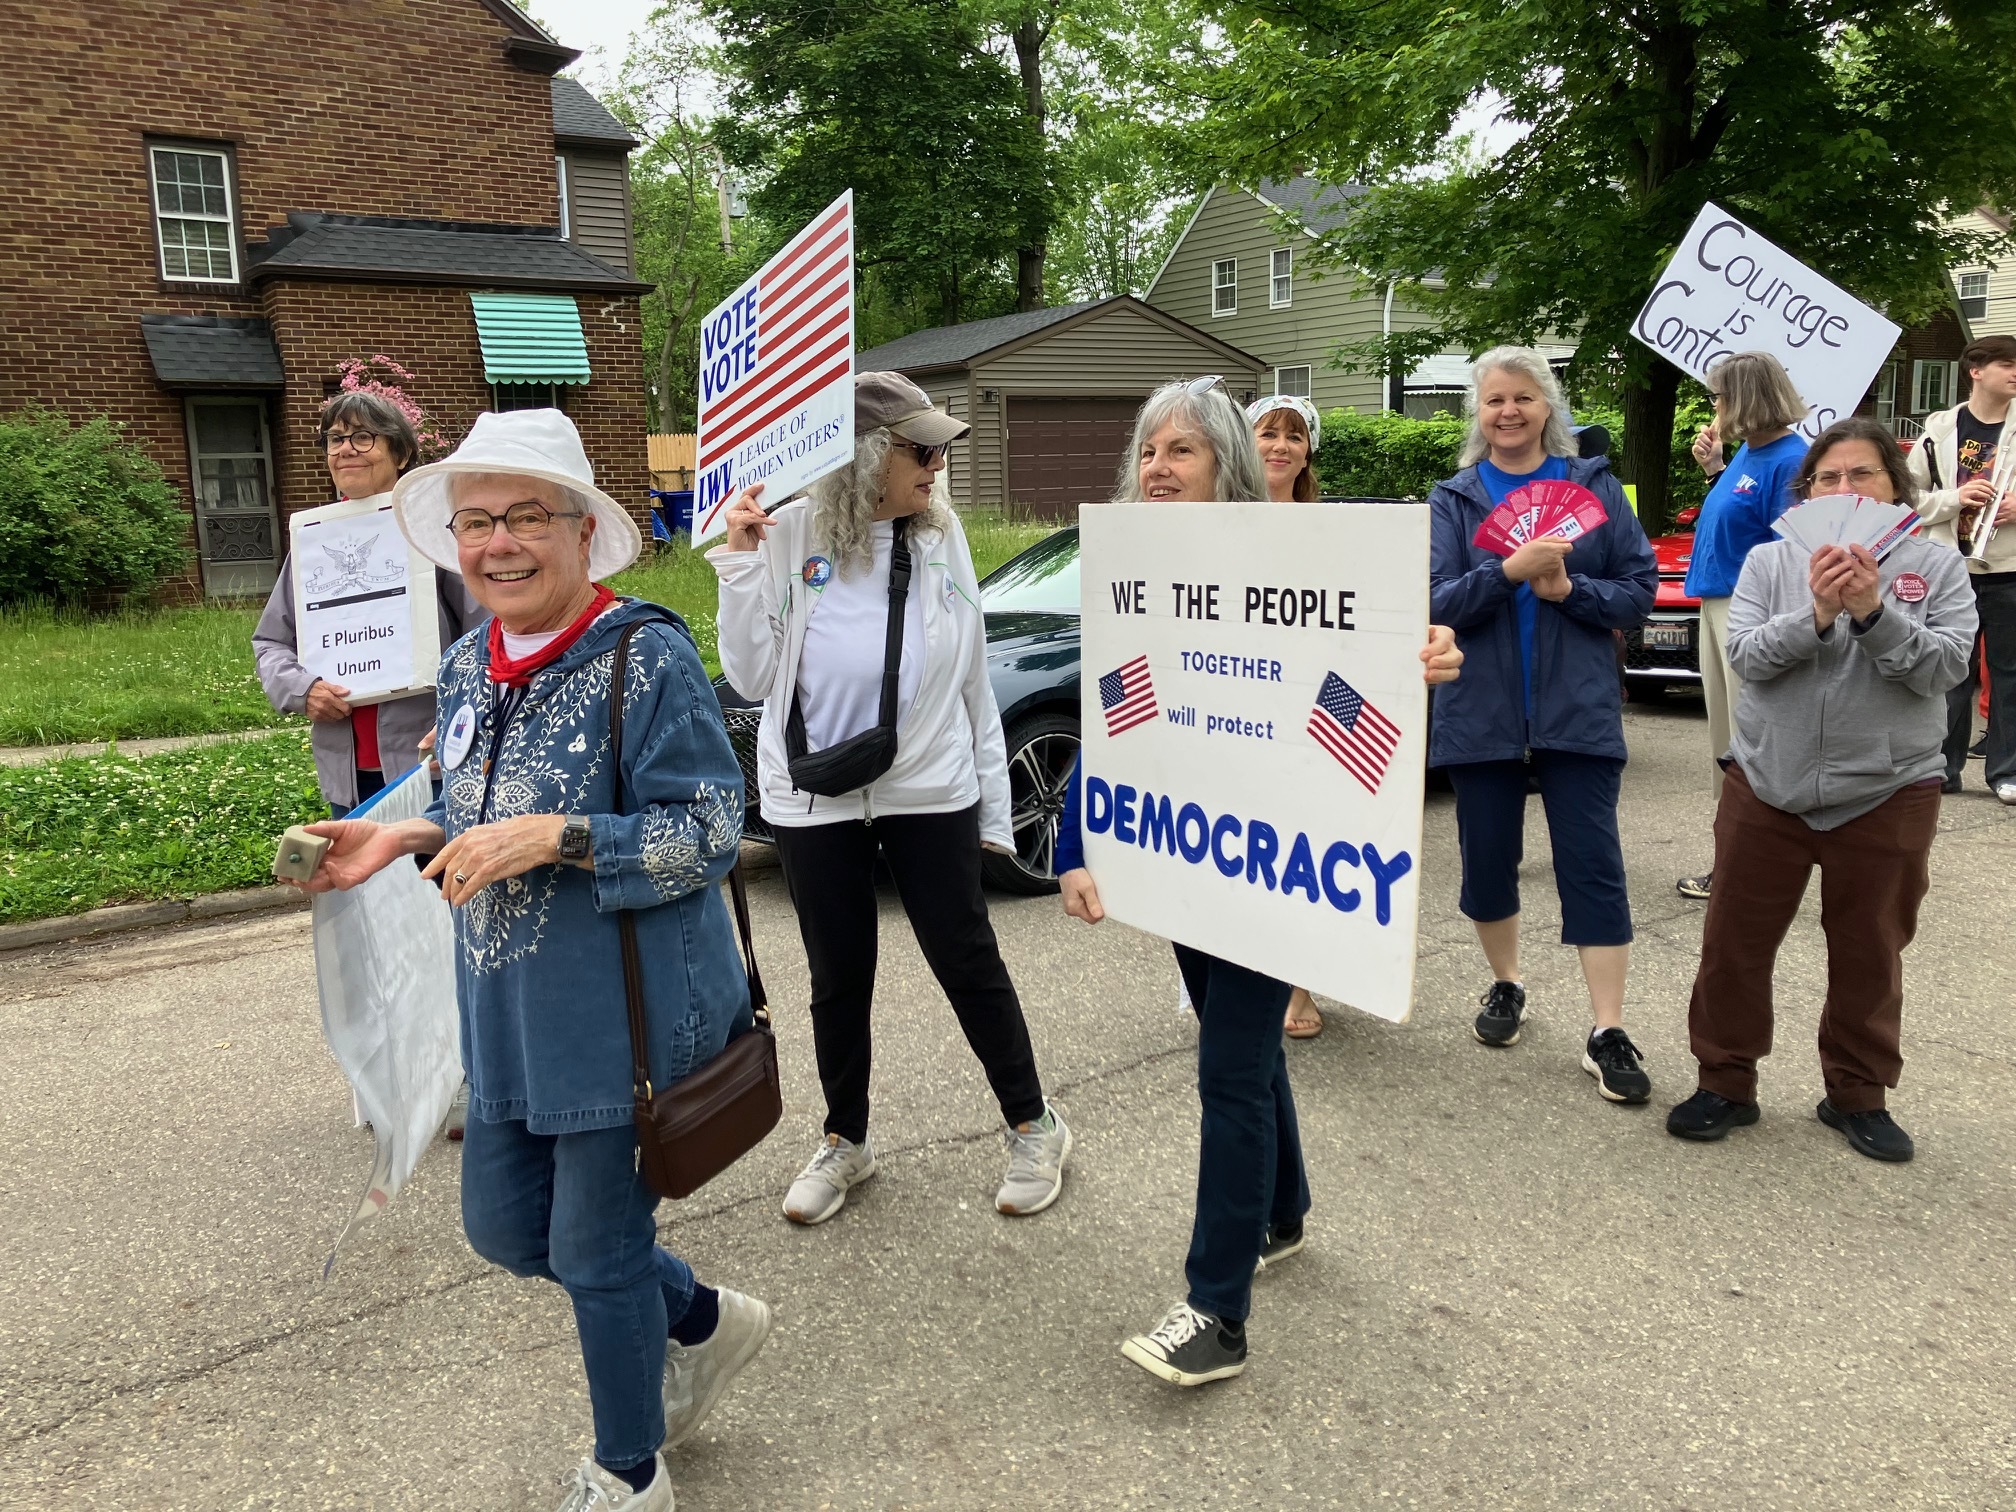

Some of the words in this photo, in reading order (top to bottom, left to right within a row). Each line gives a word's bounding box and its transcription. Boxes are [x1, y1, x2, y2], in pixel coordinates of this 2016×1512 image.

[1698, 221, 1849, 348] Courage
[704, 285, 757, 361] VOTE
[1723, 302, 1755, 336] is
[703, 329, 756, 403] VOTE
[739, 423, 787, 467] LEAGUE
[790, 410, 808, 435] OF
[698, 458, 733, 513] LWV
[738, 450, 785, 491] WOMEN
[1111, 580, 1147, 615] WE
[1171, 583, 1220, 621] THE
[1245, 586, 1356, 631] PEOPLE
[322, 634, 330, 649] E
[334, 624, 395, 647] Pluribus
[337, 658, 381, 677] Unum
[1180, 650, 1282, 683] TOGETHER
[1167, 706, 1196, 728] will
[1206, 714, 1274, 740] protect
[1086, 776, 1412, 926] DEMOCRACY
